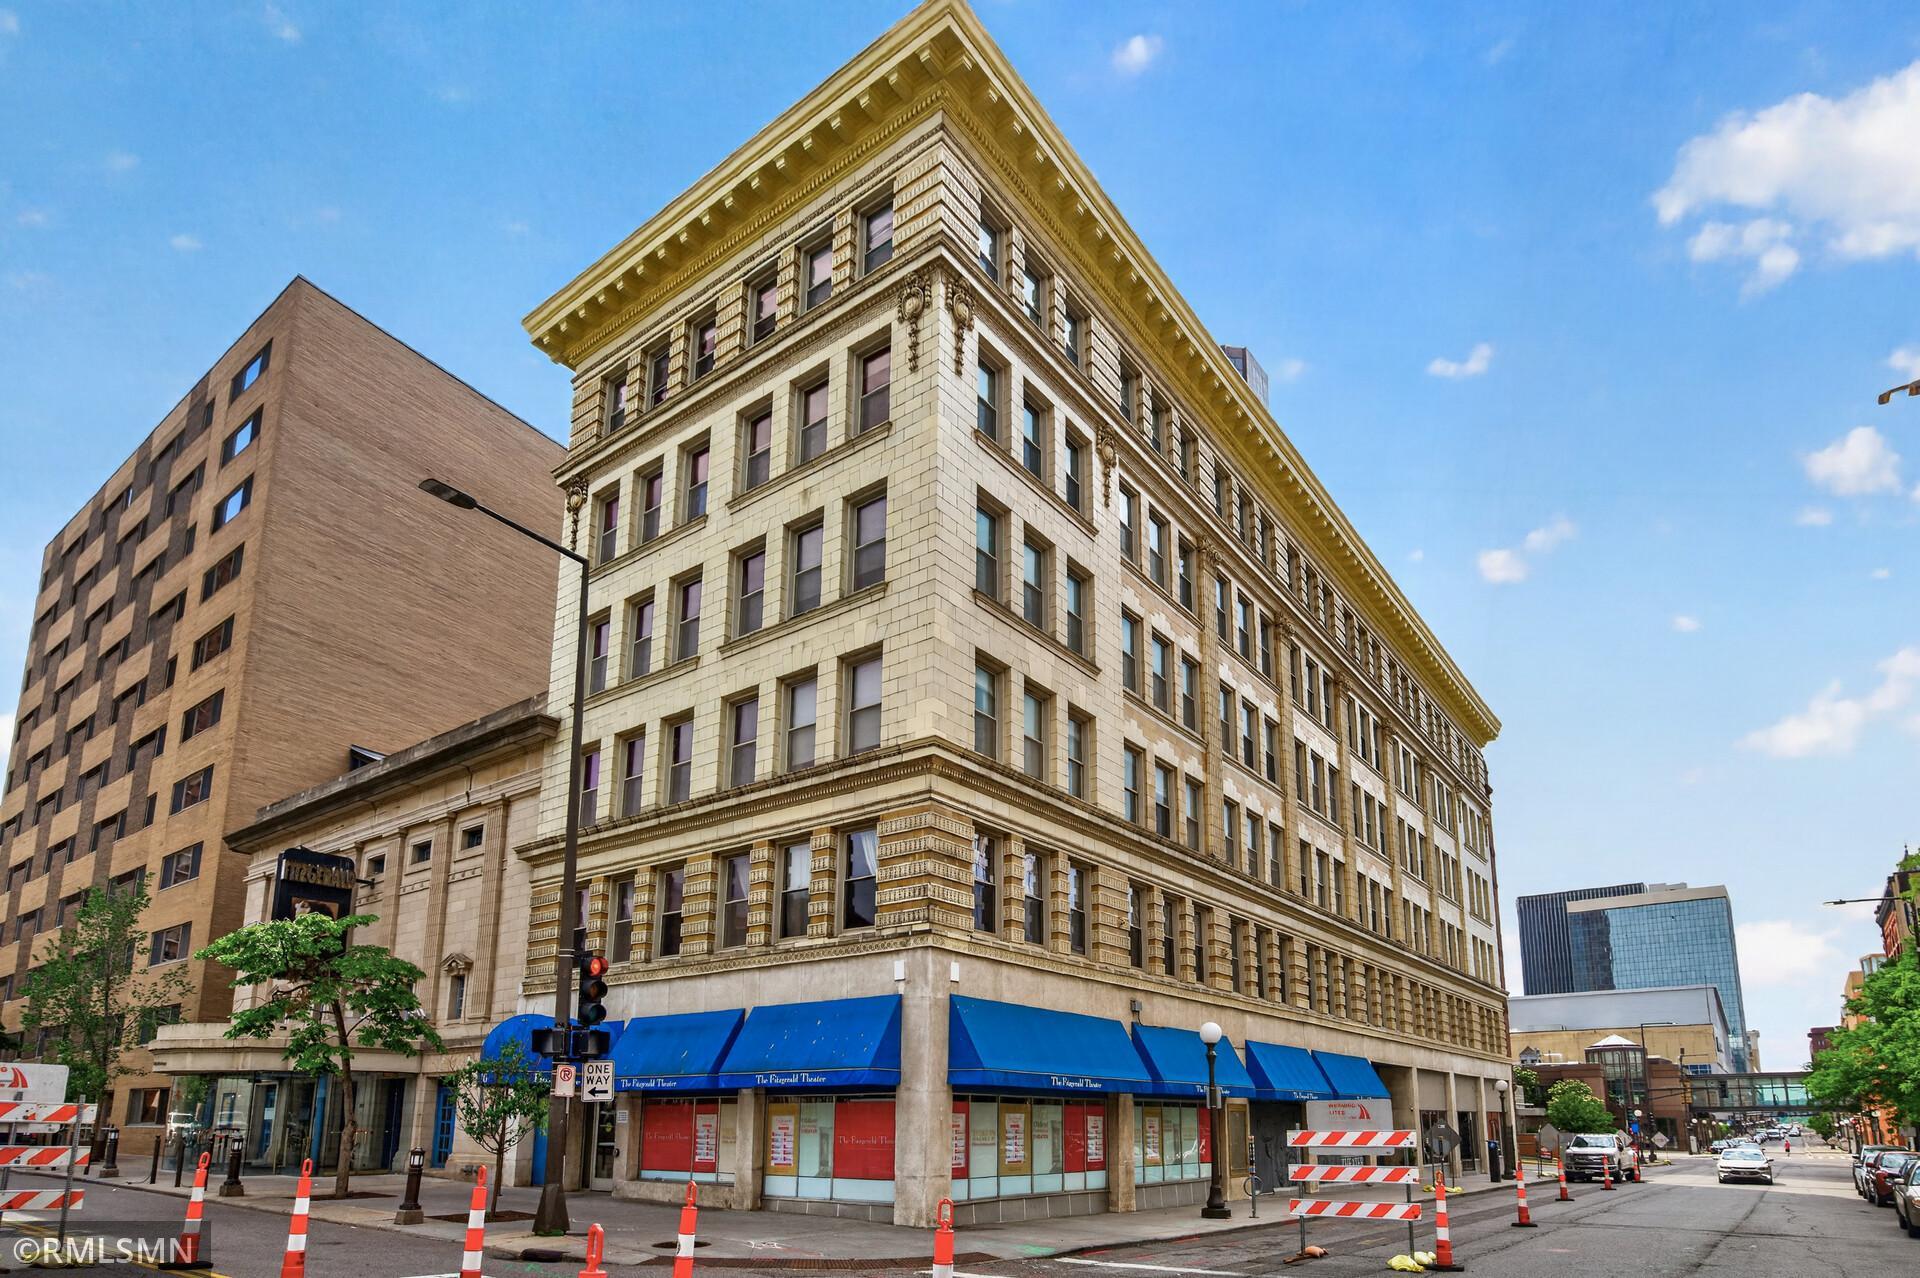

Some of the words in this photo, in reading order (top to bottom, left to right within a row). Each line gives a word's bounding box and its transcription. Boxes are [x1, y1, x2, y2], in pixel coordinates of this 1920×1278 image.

[587, 1064, 611, 1075] ONE
[586, 1075, 611, 1085] WAY
[755, 1074, 769, 1085] The
[769, 1073, 799, 1085] Fitzgerald
[800, 1072, 827, 1083] Theater
[1050, 1076, 1062, 1086] The
